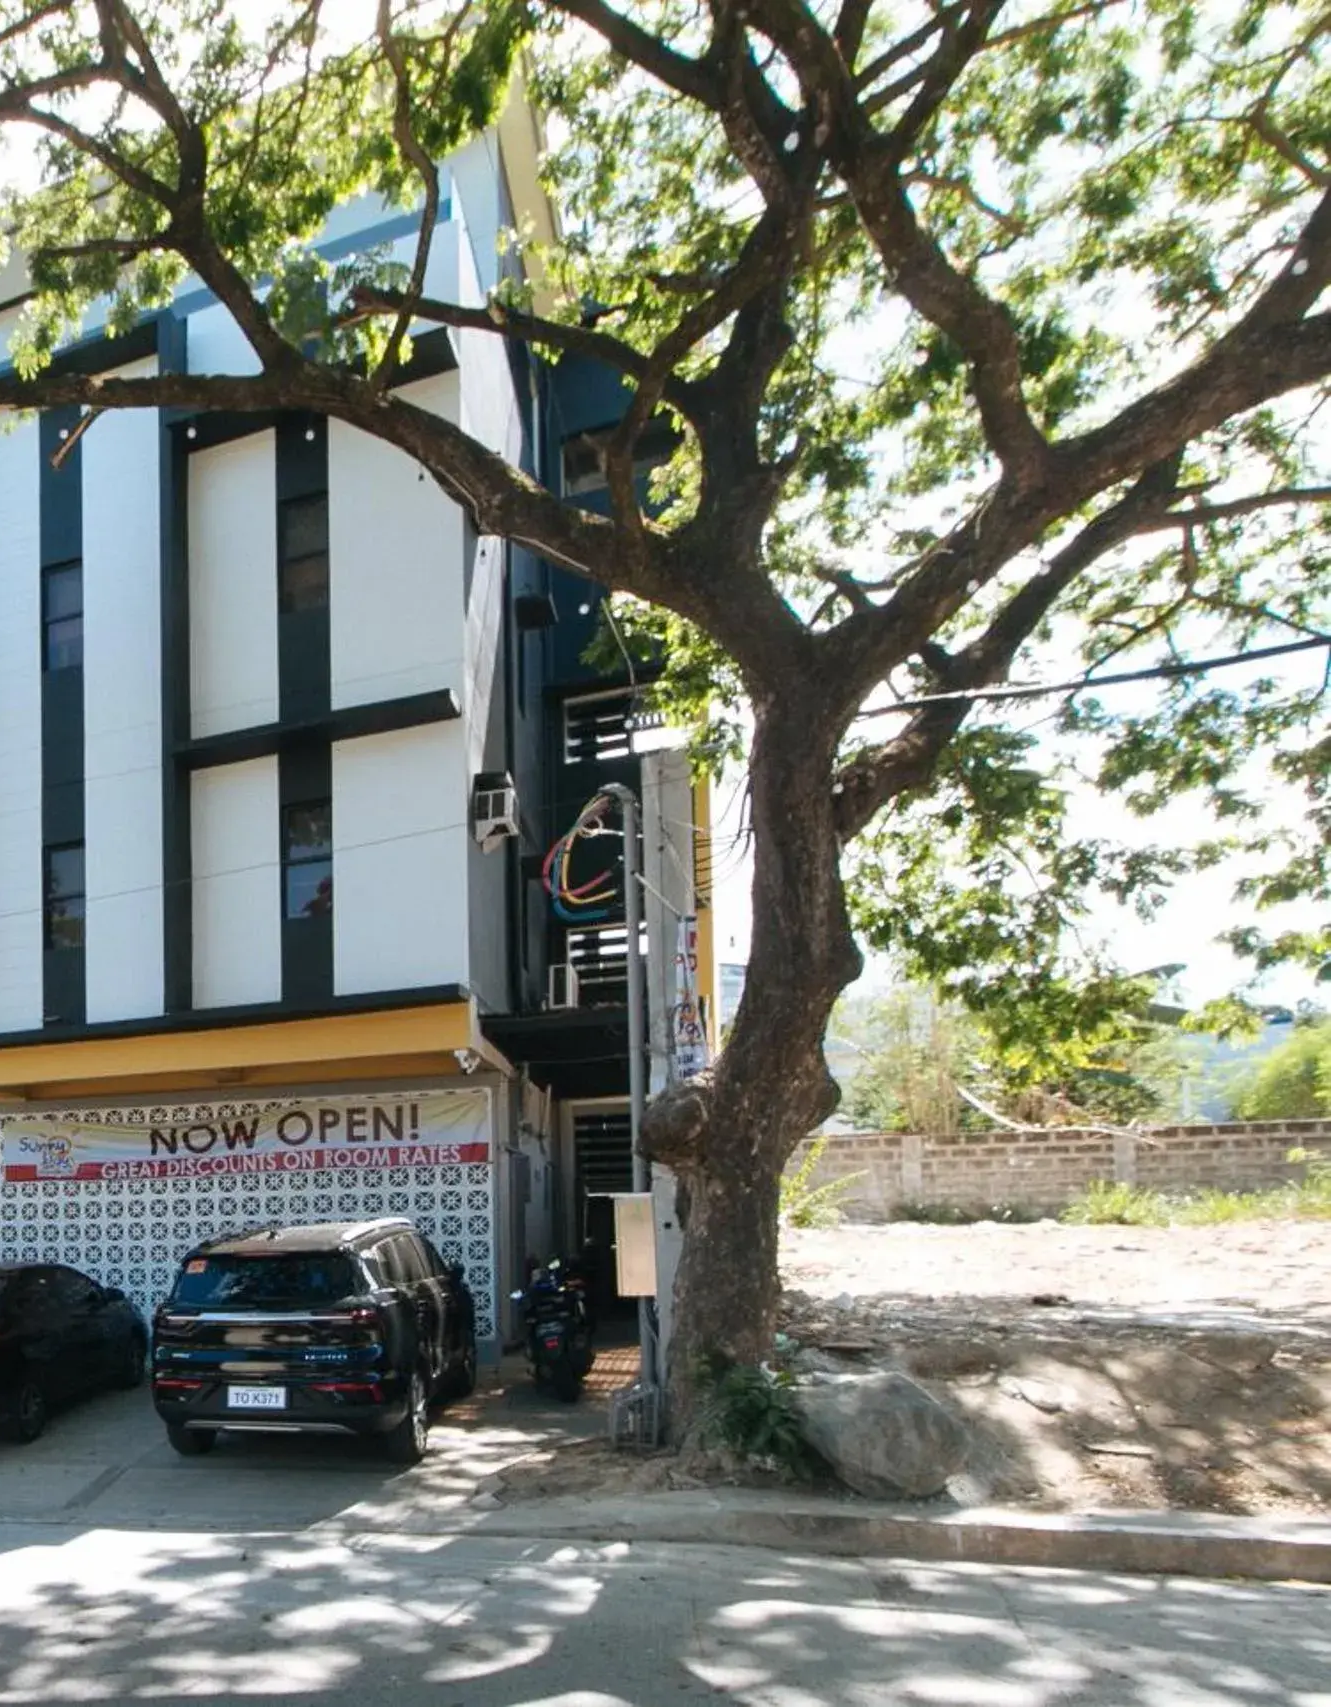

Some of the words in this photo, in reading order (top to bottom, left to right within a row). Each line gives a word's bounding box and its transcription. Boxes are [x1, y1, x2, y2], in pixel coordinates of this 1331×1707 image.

[150, 1116, 260, 1156] NOW
[276, 1102, 420, 1146] OPEN!
[101, 1160, 161, 1179] GREAT
[170, 1153, 277, 1177] DISCOUNTS
[283, 1151, 316, 1169] ON
[323, 1148, 392, 1168] ROOM
[398, 1146, 462, 1165] RATES
